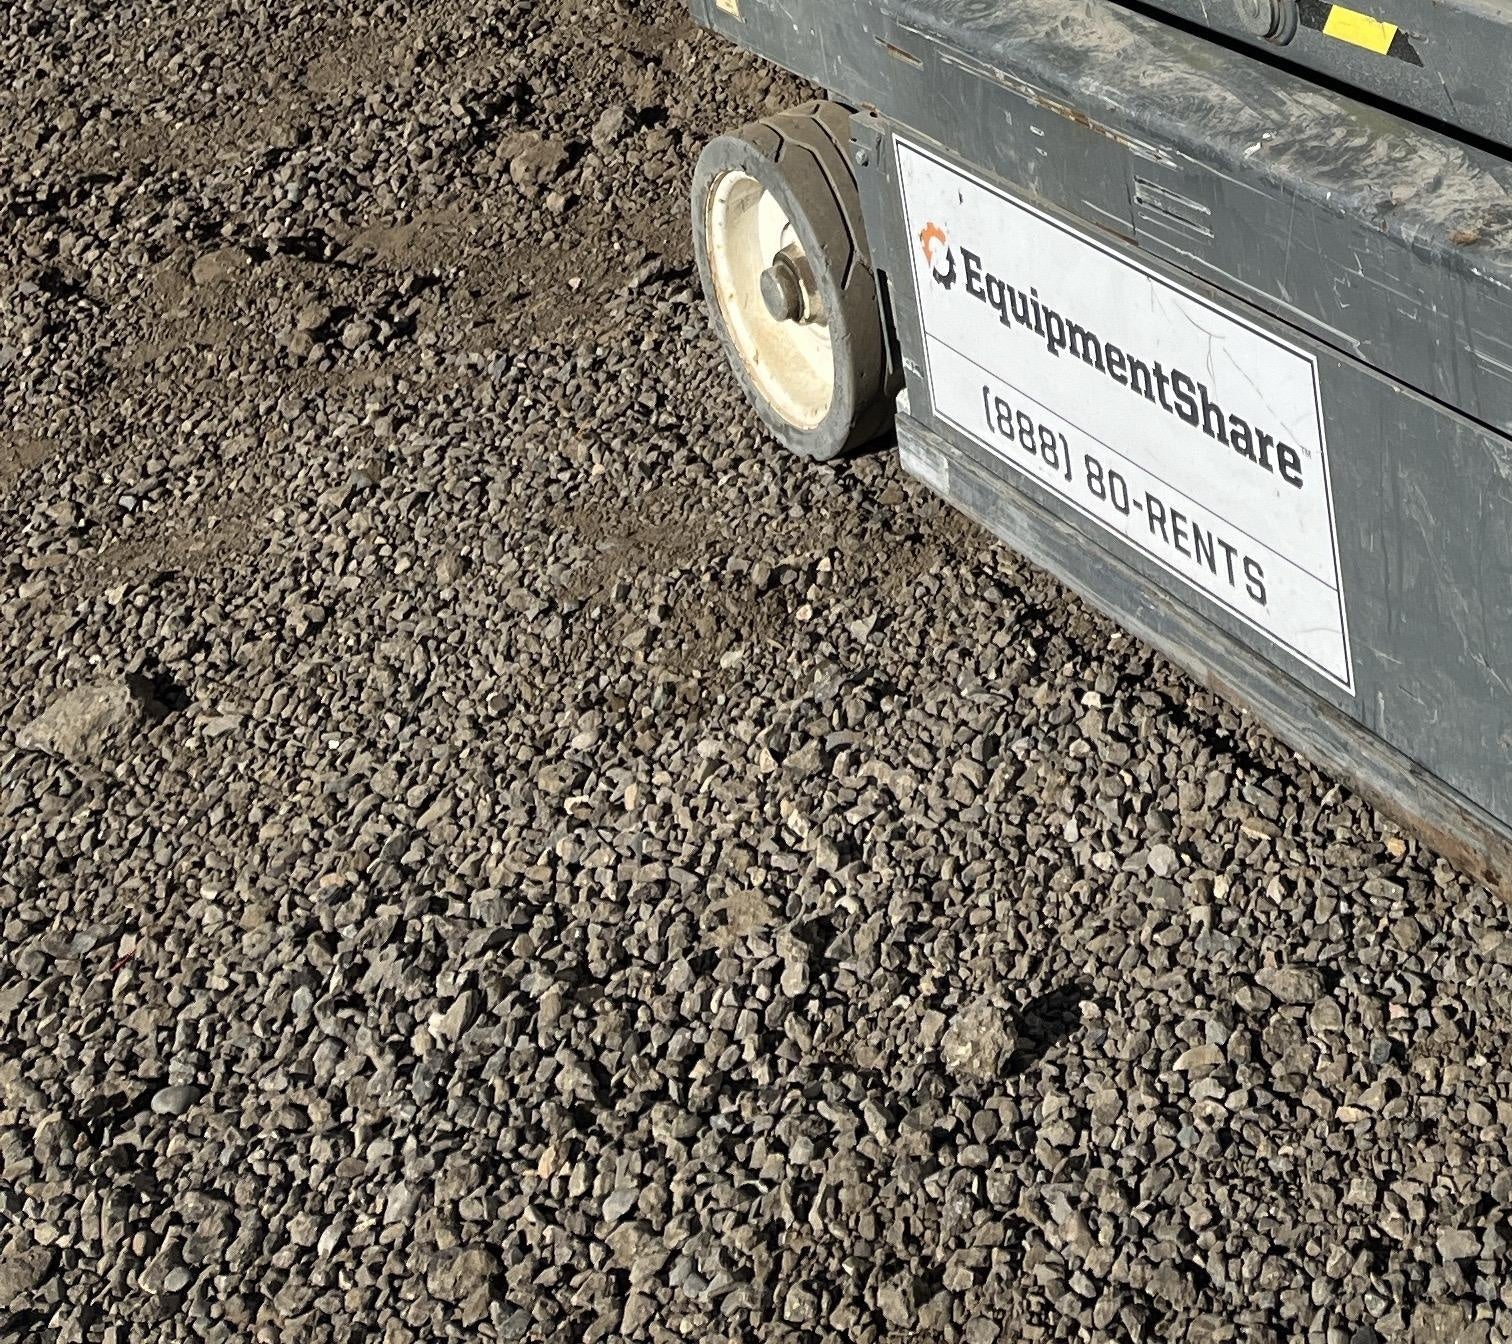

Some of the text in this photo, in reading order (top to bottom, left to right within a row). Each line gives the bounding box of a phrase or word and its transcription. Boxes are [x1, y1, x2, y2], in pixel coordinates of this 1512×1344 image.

[959, 245, 1304, 490] EquipmentShare
[982, 384, 1268, 608] (888) 80-RENTS
